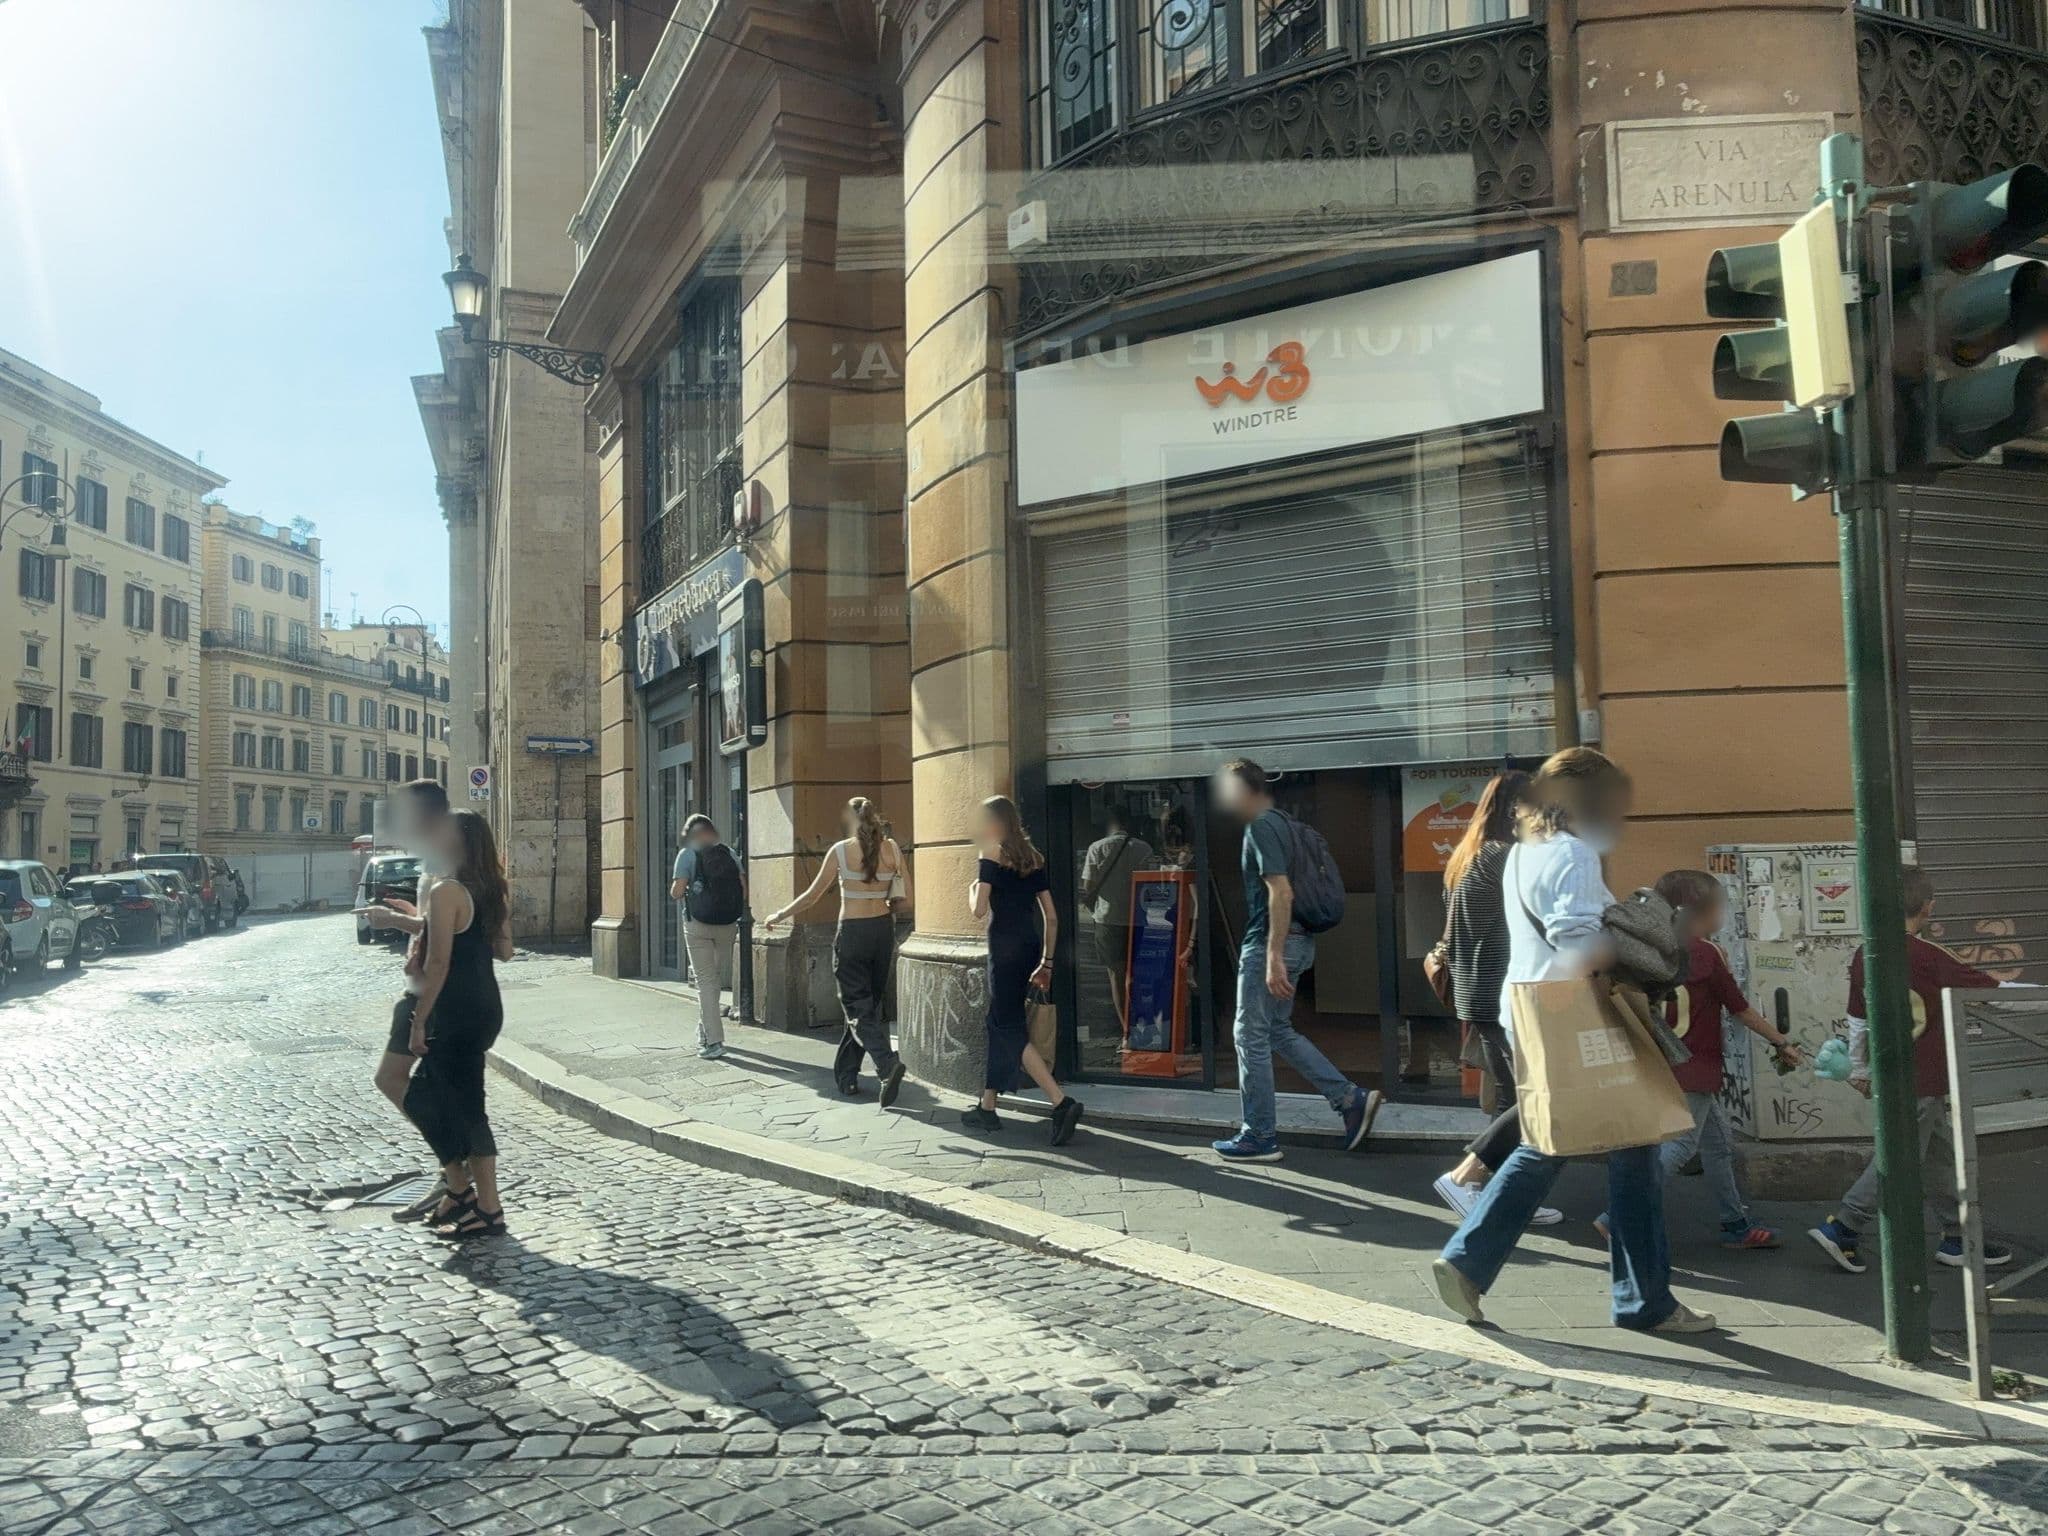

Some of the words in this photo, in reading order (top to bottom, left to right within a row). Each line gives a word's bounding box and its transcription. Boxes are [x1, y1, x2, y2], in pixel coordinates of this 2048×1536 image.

[1693, 140, 1748, 162] VIA
[1649, 180, 1799, 208] ARENULA
[1212, 405, 1299, 435] WINDTRE
[1411, 769, 1438, 780] FOR
[1772, 1096, 1825, 1136] NESS
